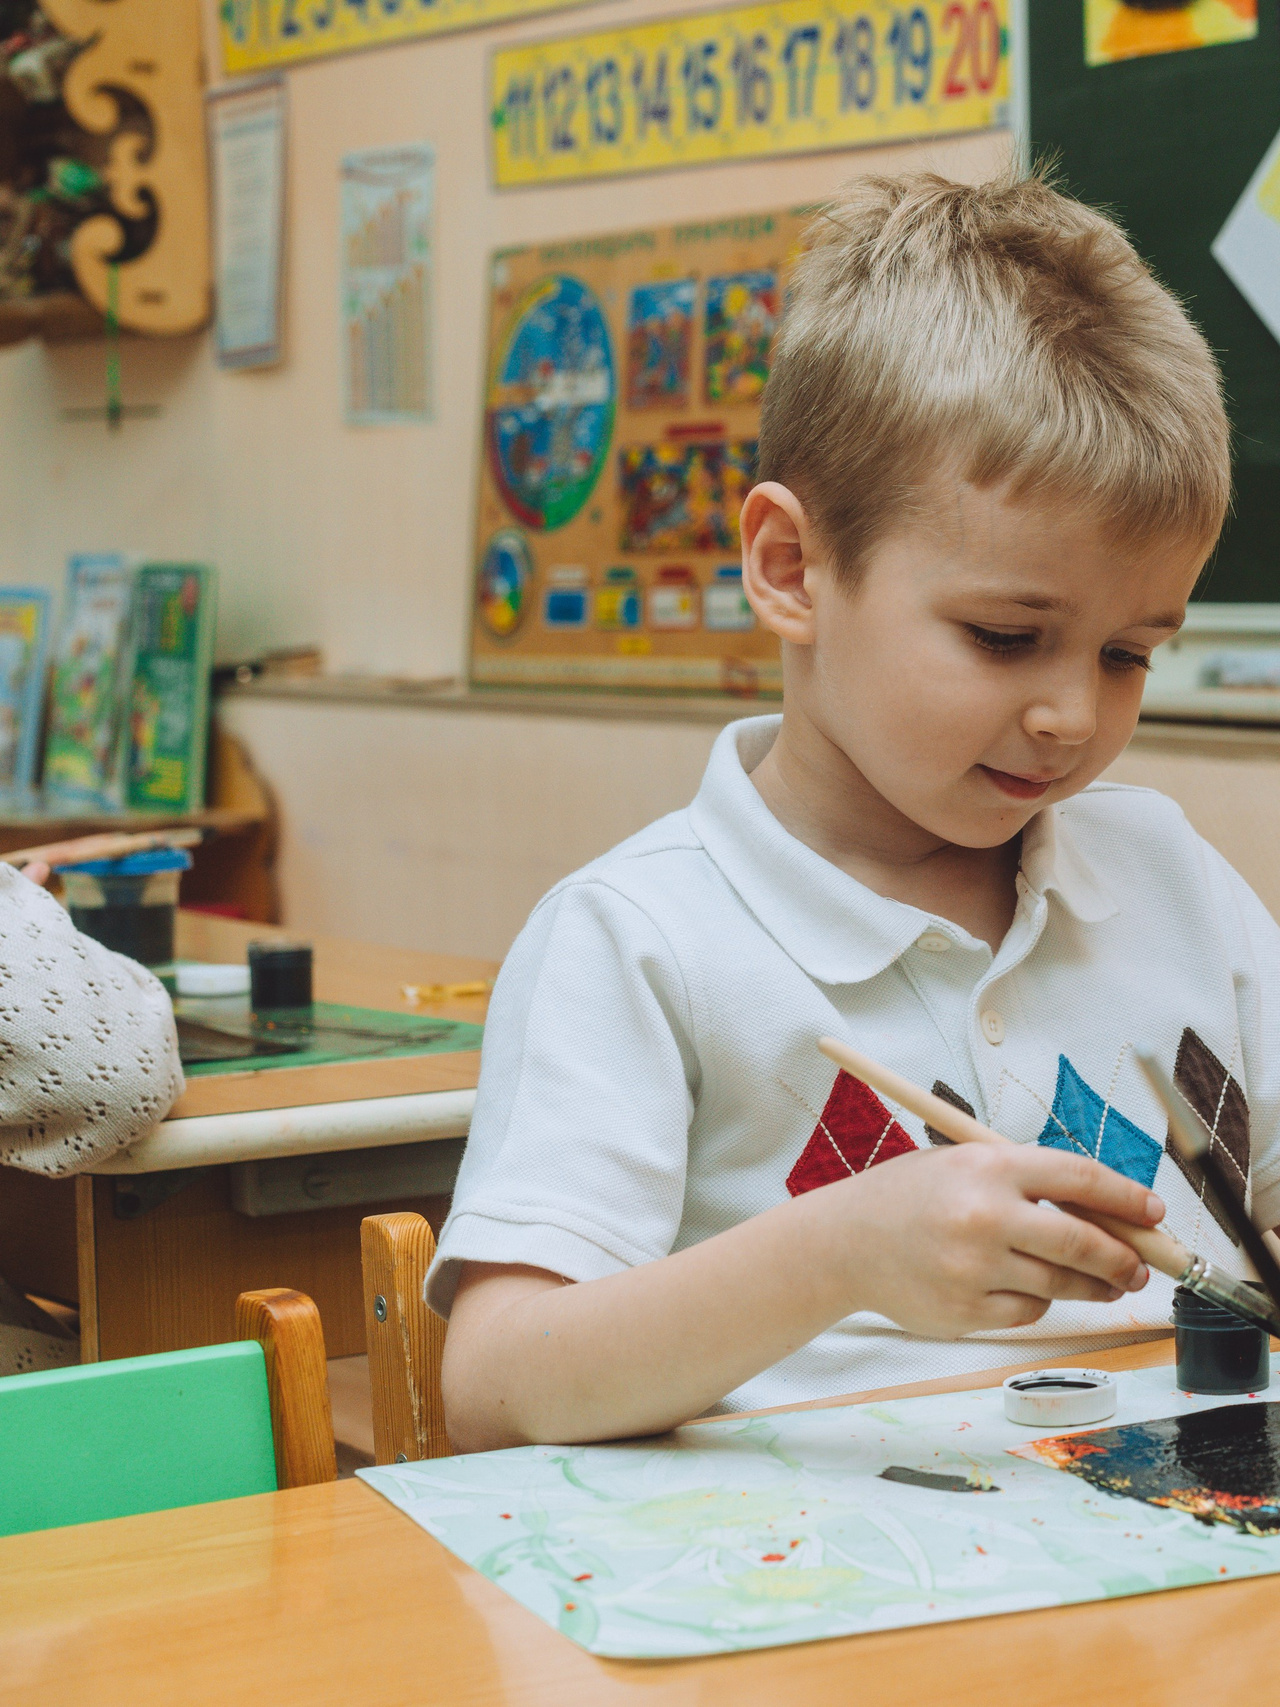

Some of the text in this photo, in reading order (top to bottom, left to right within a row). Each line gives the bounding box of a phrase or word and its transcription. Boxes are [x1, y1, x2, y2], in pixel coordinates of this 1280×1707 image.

[504, 0, 1000, 157] 11 12 13 14 15 16 17 18 19 20
